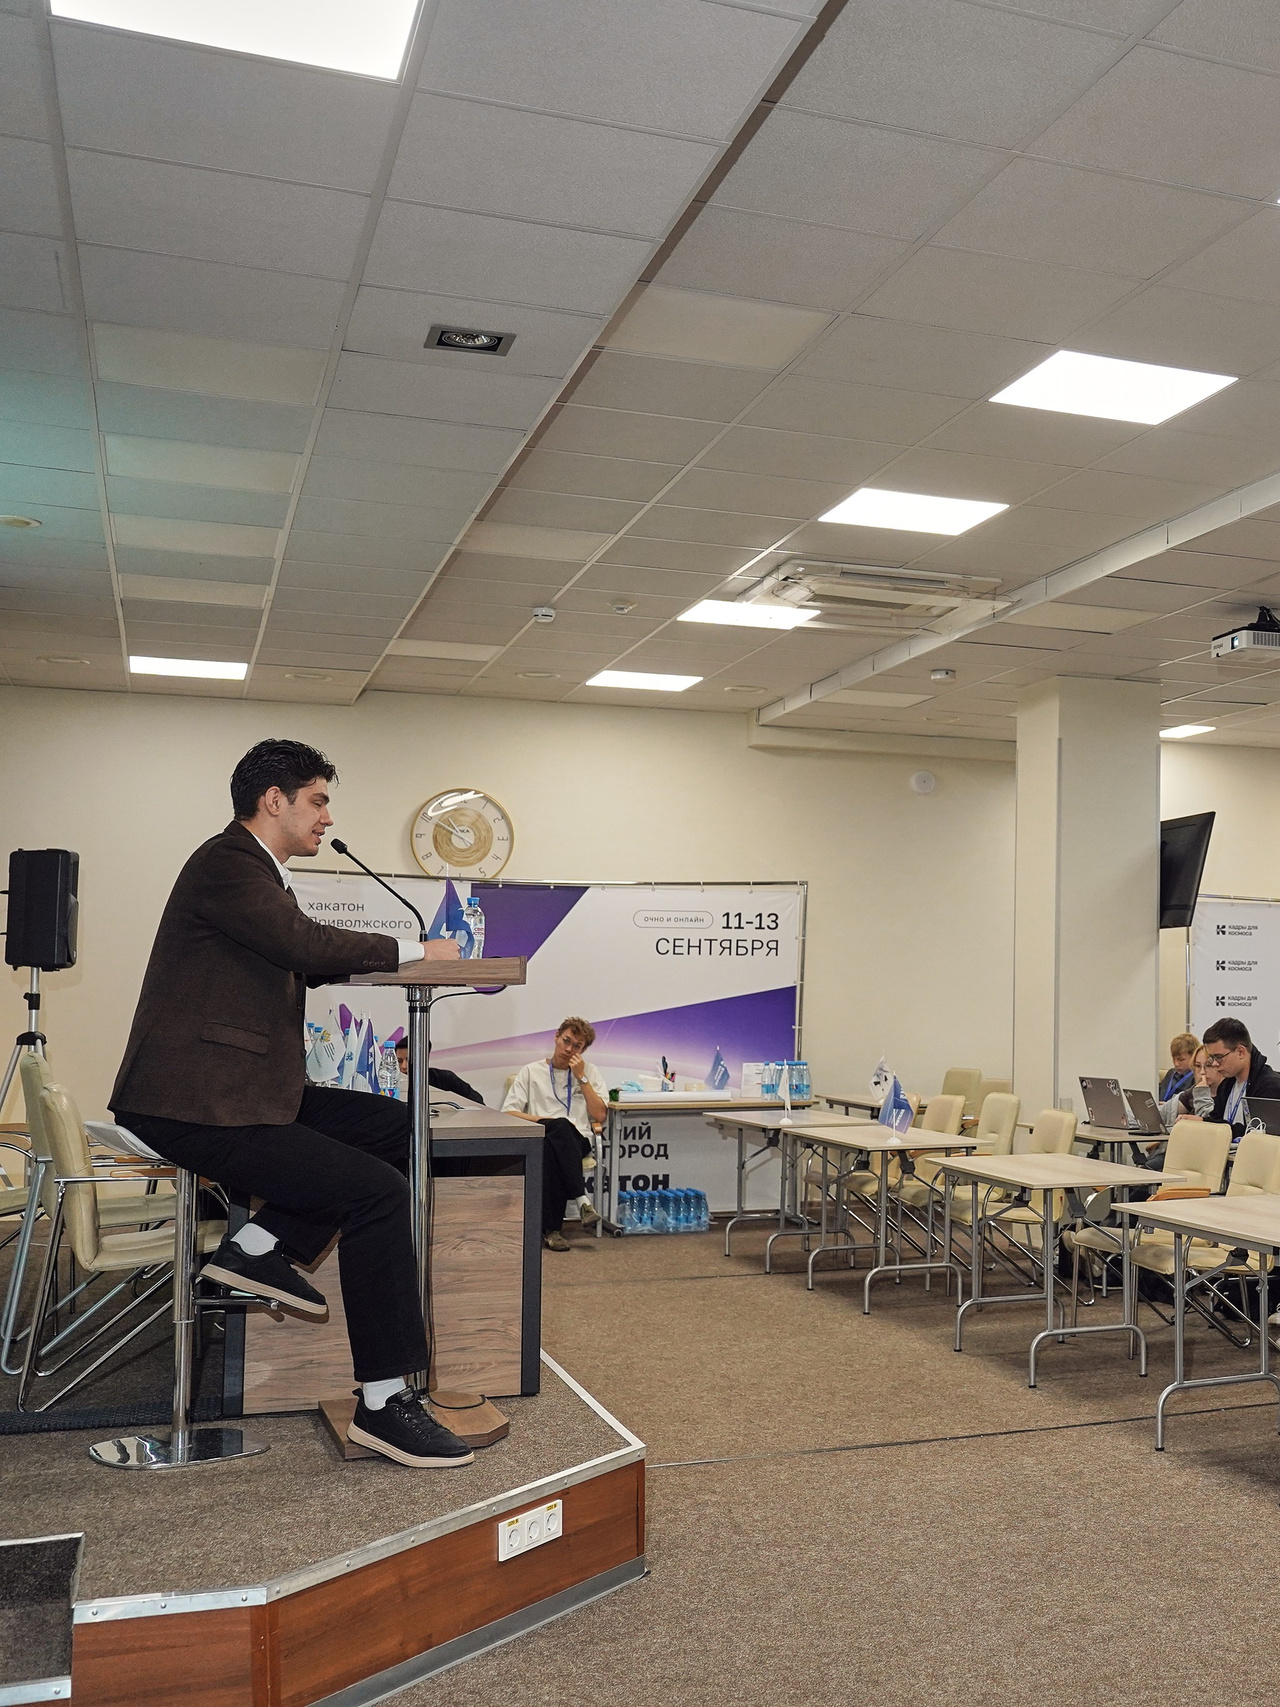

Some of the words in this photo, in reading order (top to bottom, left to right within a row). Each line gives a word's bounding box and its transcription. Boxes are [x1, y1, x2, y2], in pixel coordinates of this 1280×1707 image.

[307, 902, 365, 912] хакатон
[721, 911, 780, 930] 11-13
[655, 937, 779, 957] СЕНТЯБРЯ
